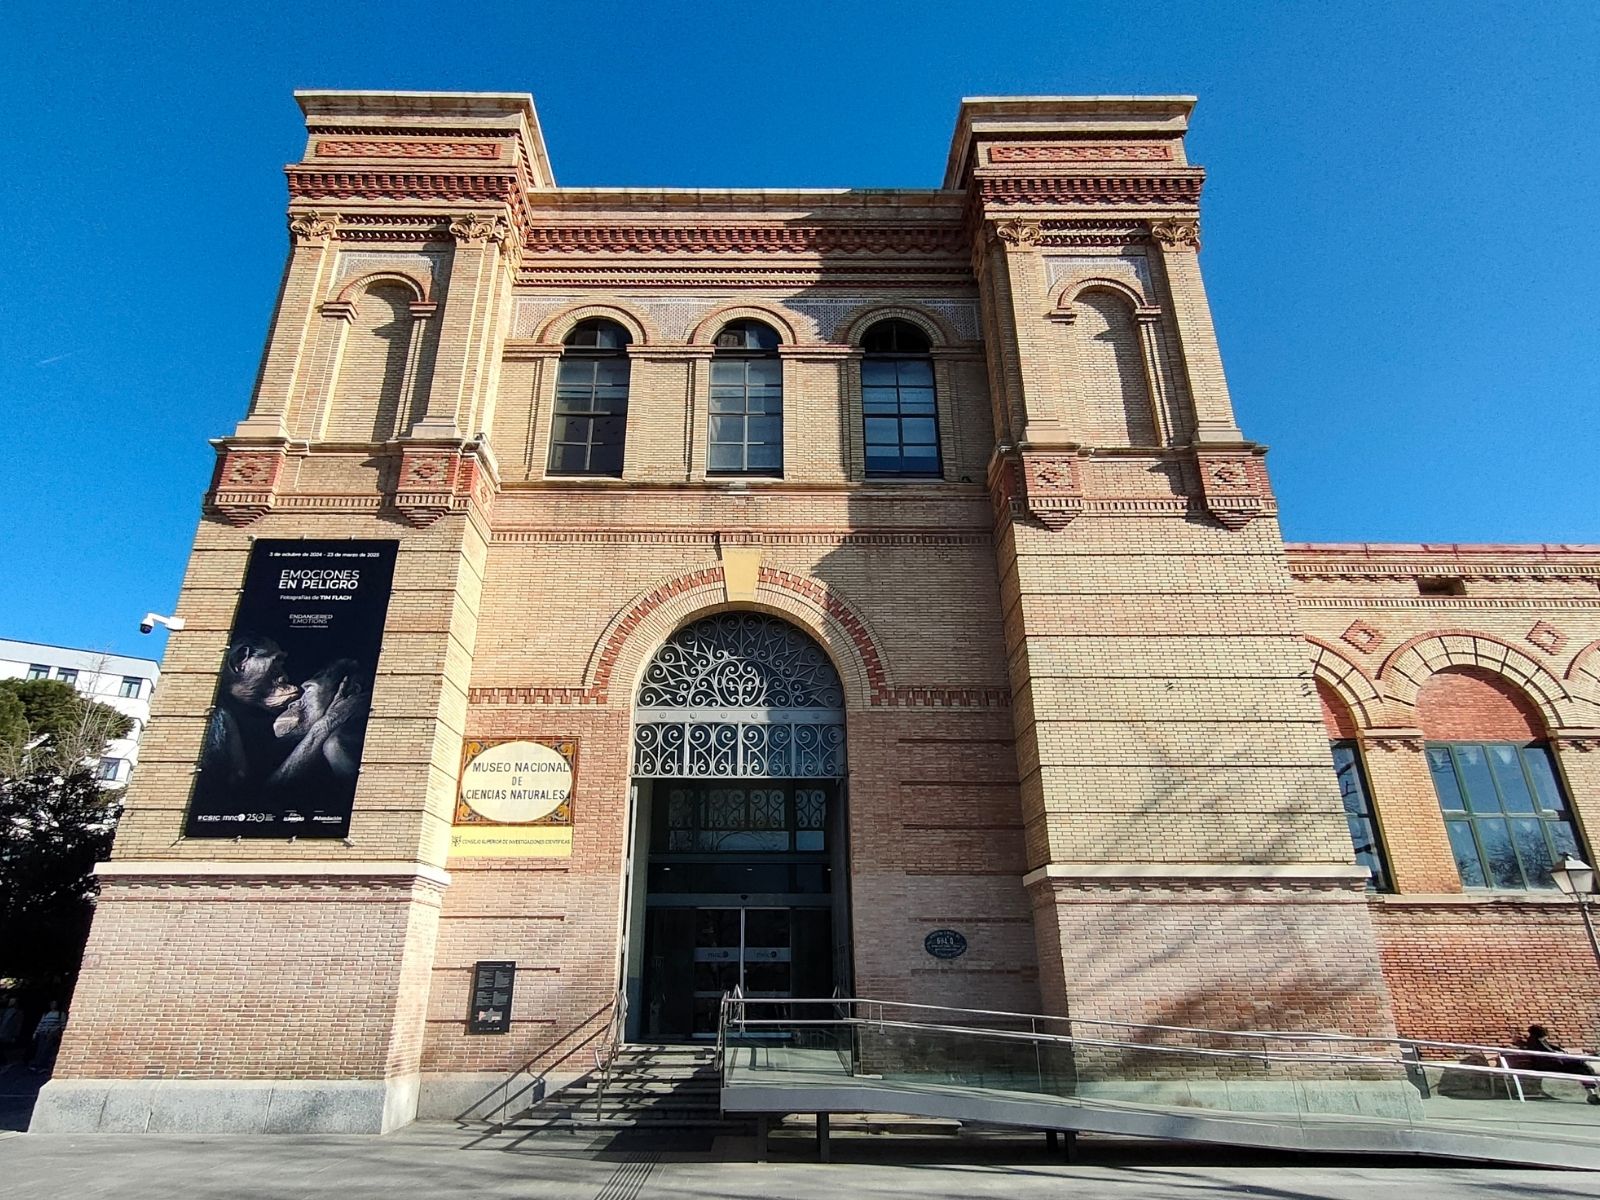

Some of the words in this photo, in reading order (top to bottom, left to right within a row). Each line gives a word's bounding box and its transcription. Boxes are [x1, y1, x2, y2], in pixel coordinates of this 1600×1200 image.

[281, 569, 360, 580] EMOCIONES
[278, 580, 297, 589] EN
[302, 580, 358, 590] PELIGRO
[472, 762, 511, 773] MUSEO
[514, 762, 569, 773] NACIONAL
[511, 776, 523, 786] DE
[466, 789, 507, 800] CIENCIAS
[510, 789, 565, 800] NATURALES
